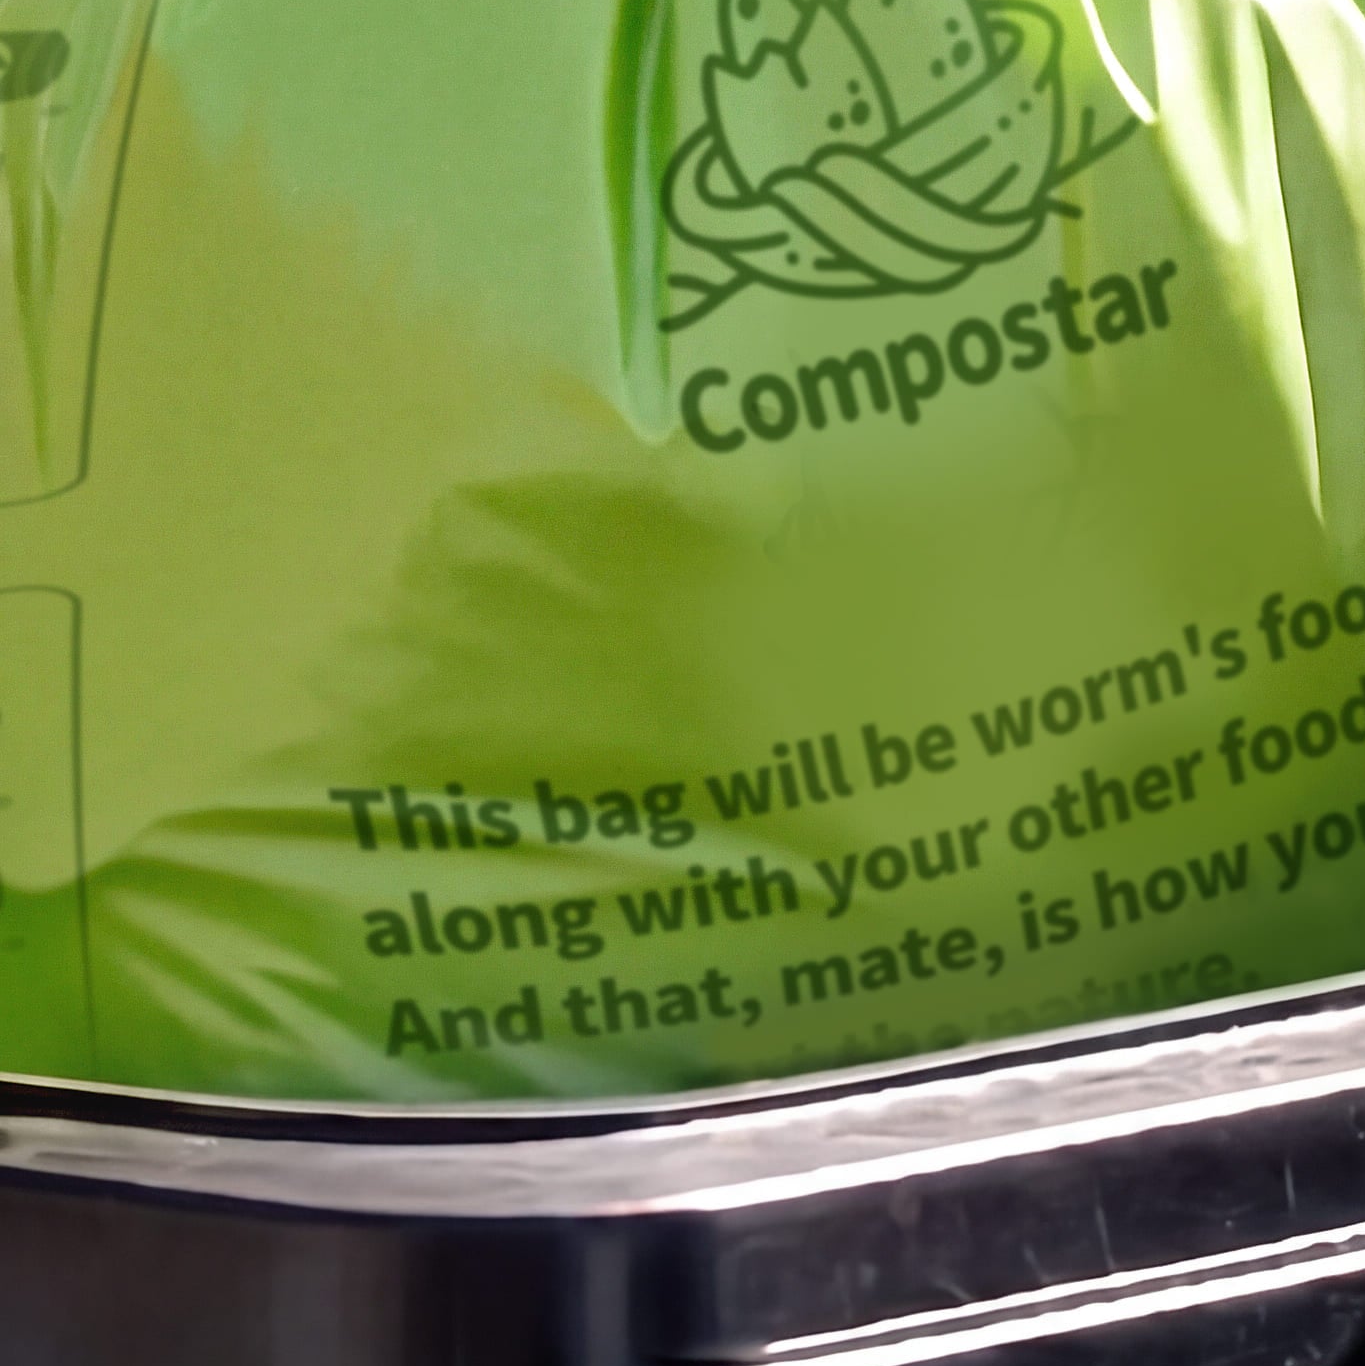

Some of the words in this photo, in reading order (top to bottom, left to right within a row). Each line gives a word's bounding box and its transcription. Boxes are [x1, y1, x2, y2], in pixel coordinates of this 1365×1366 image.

[680, 258, 1177, 453] Compostar
[329, 782, 521, 851] This
[534, 780, 696, 849] bag
[705, 733, 854, 820] will
[861, 724, 957, 789] be
[970, 624, 1247, 757] worm's
[363, 891, 605, 961] along
[617, 856, 799, 936] with
[815, 816, 990, 918] your
[1008, 742, 1205, 852] other
[385, 985, 544, 1057] And
[562, 967, 762, 1040] that,
[781, 923, 1005, 1007] mate,
[1017, 891, 1080, 952] is
[1093, 842, 1249, 929] how
